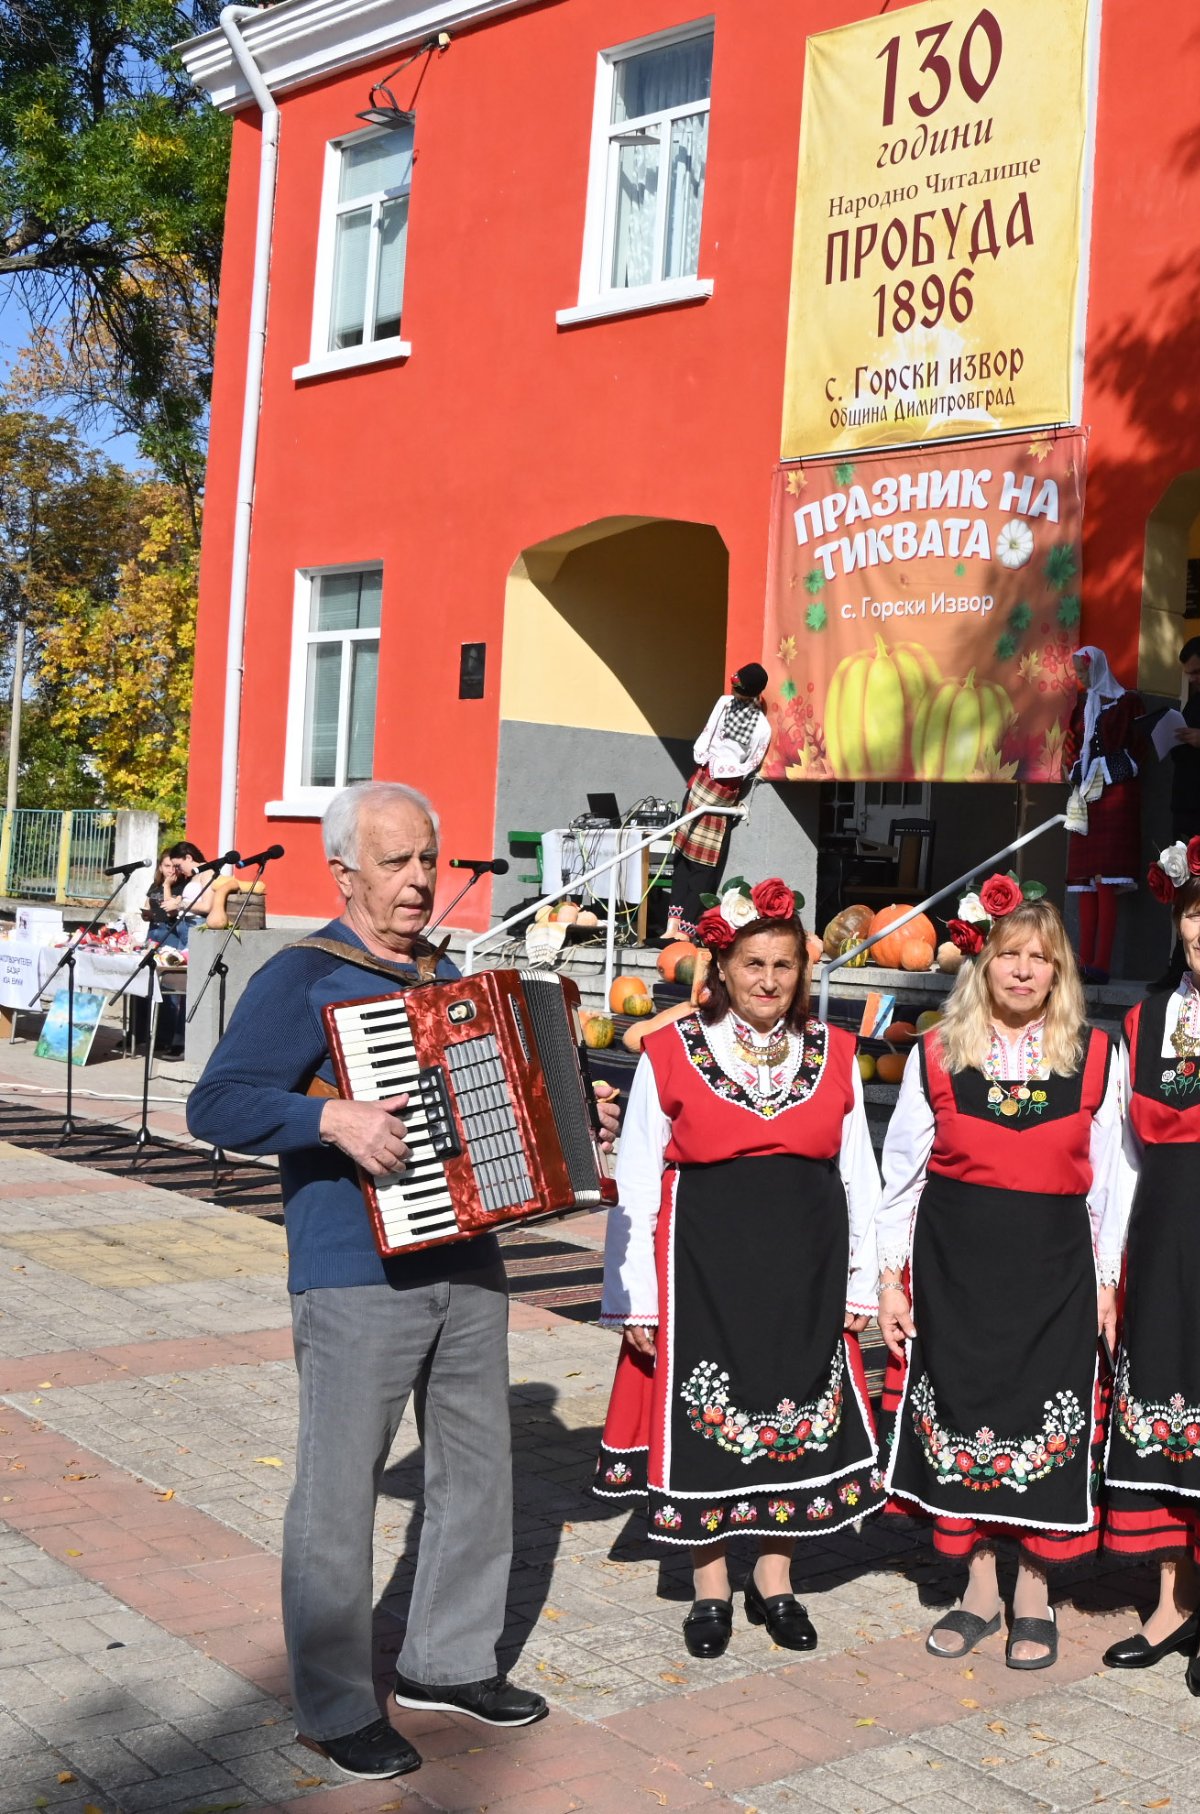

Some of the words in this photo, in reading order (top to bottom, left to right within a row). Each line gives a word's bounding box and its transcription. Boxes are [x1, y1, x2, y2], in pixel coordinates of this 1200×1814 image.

[875, 7, 1003, 127] 130
[876, 117, 994, 169] години
[827, 183, 919, 219] Народно
[925, 157, 1041, 196] Читалище
[824, 191, 1035, 285] ПРОБУДА
[872, 267, 976, 338] 1896
[825, 375, 843, 403] с.
[854, 359, 939, 399] Горски
[893, 385, 1016, 422] Димитровград
[793, 468, 993, 547] ПРАЗНИК
[998, 470, 1060, 524] НА
[813, 517, 991, 581] ТИКВАТА
[840, 606, 857, 620] с.
[861, 596, 926, 622] Горски
[930, 592, 994, 617] Извор
